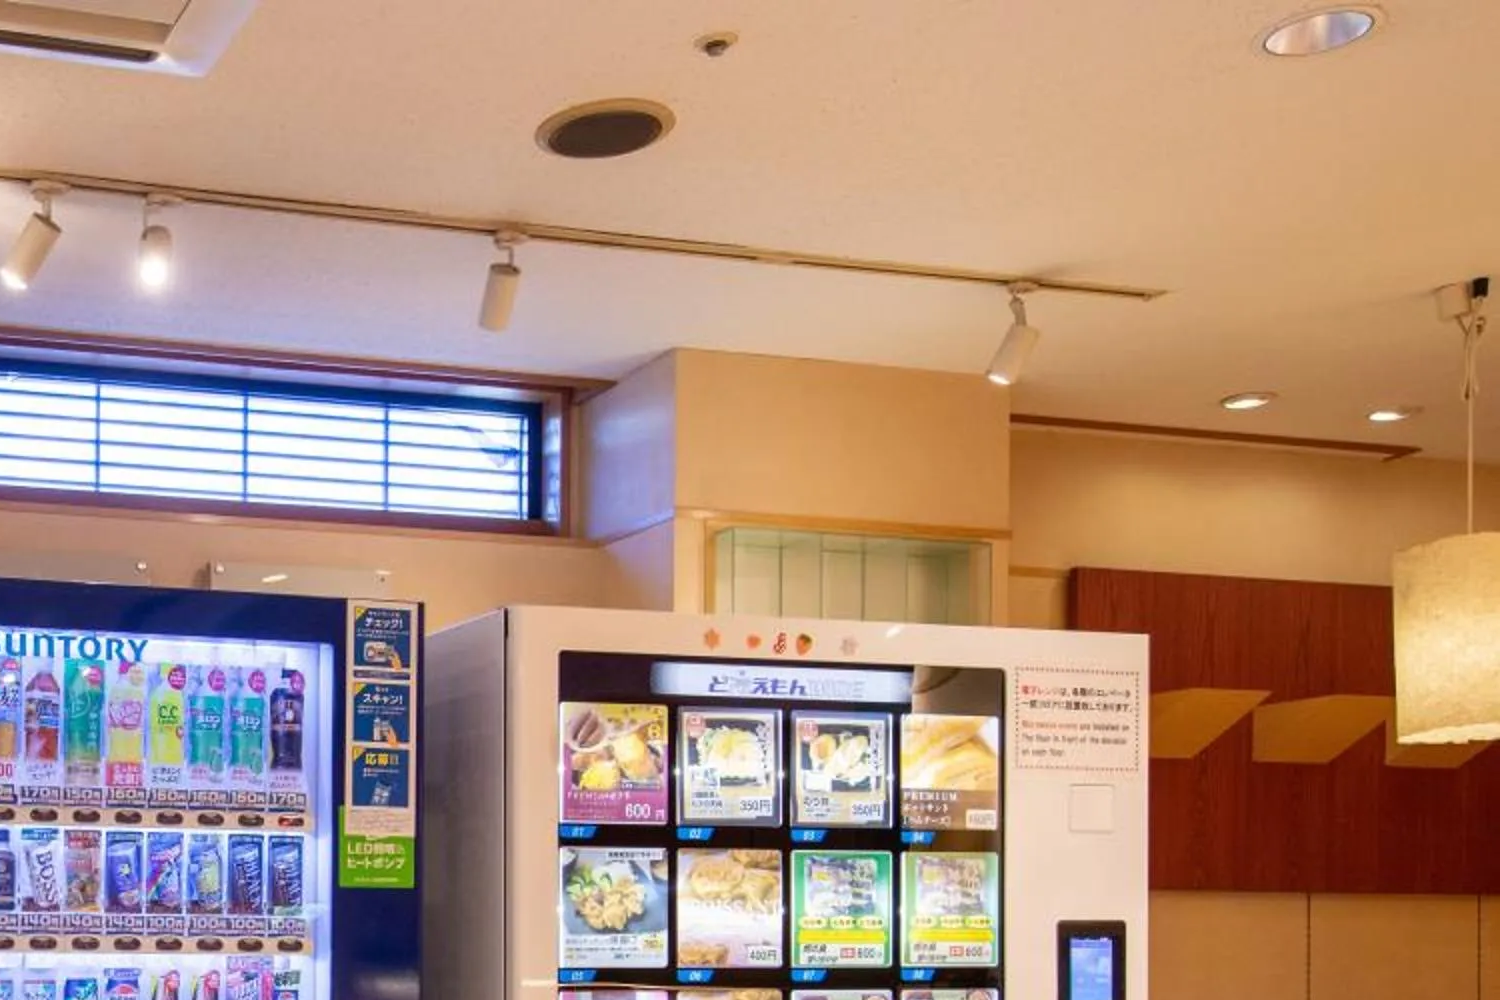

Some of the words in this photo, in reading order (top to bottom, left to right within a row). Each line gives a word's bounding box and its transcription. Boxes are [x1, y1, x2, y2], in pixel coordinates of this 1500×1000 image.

[363, 693, 404, 706] スキャン!
[902, 791, 958, 802] PREMIUM
